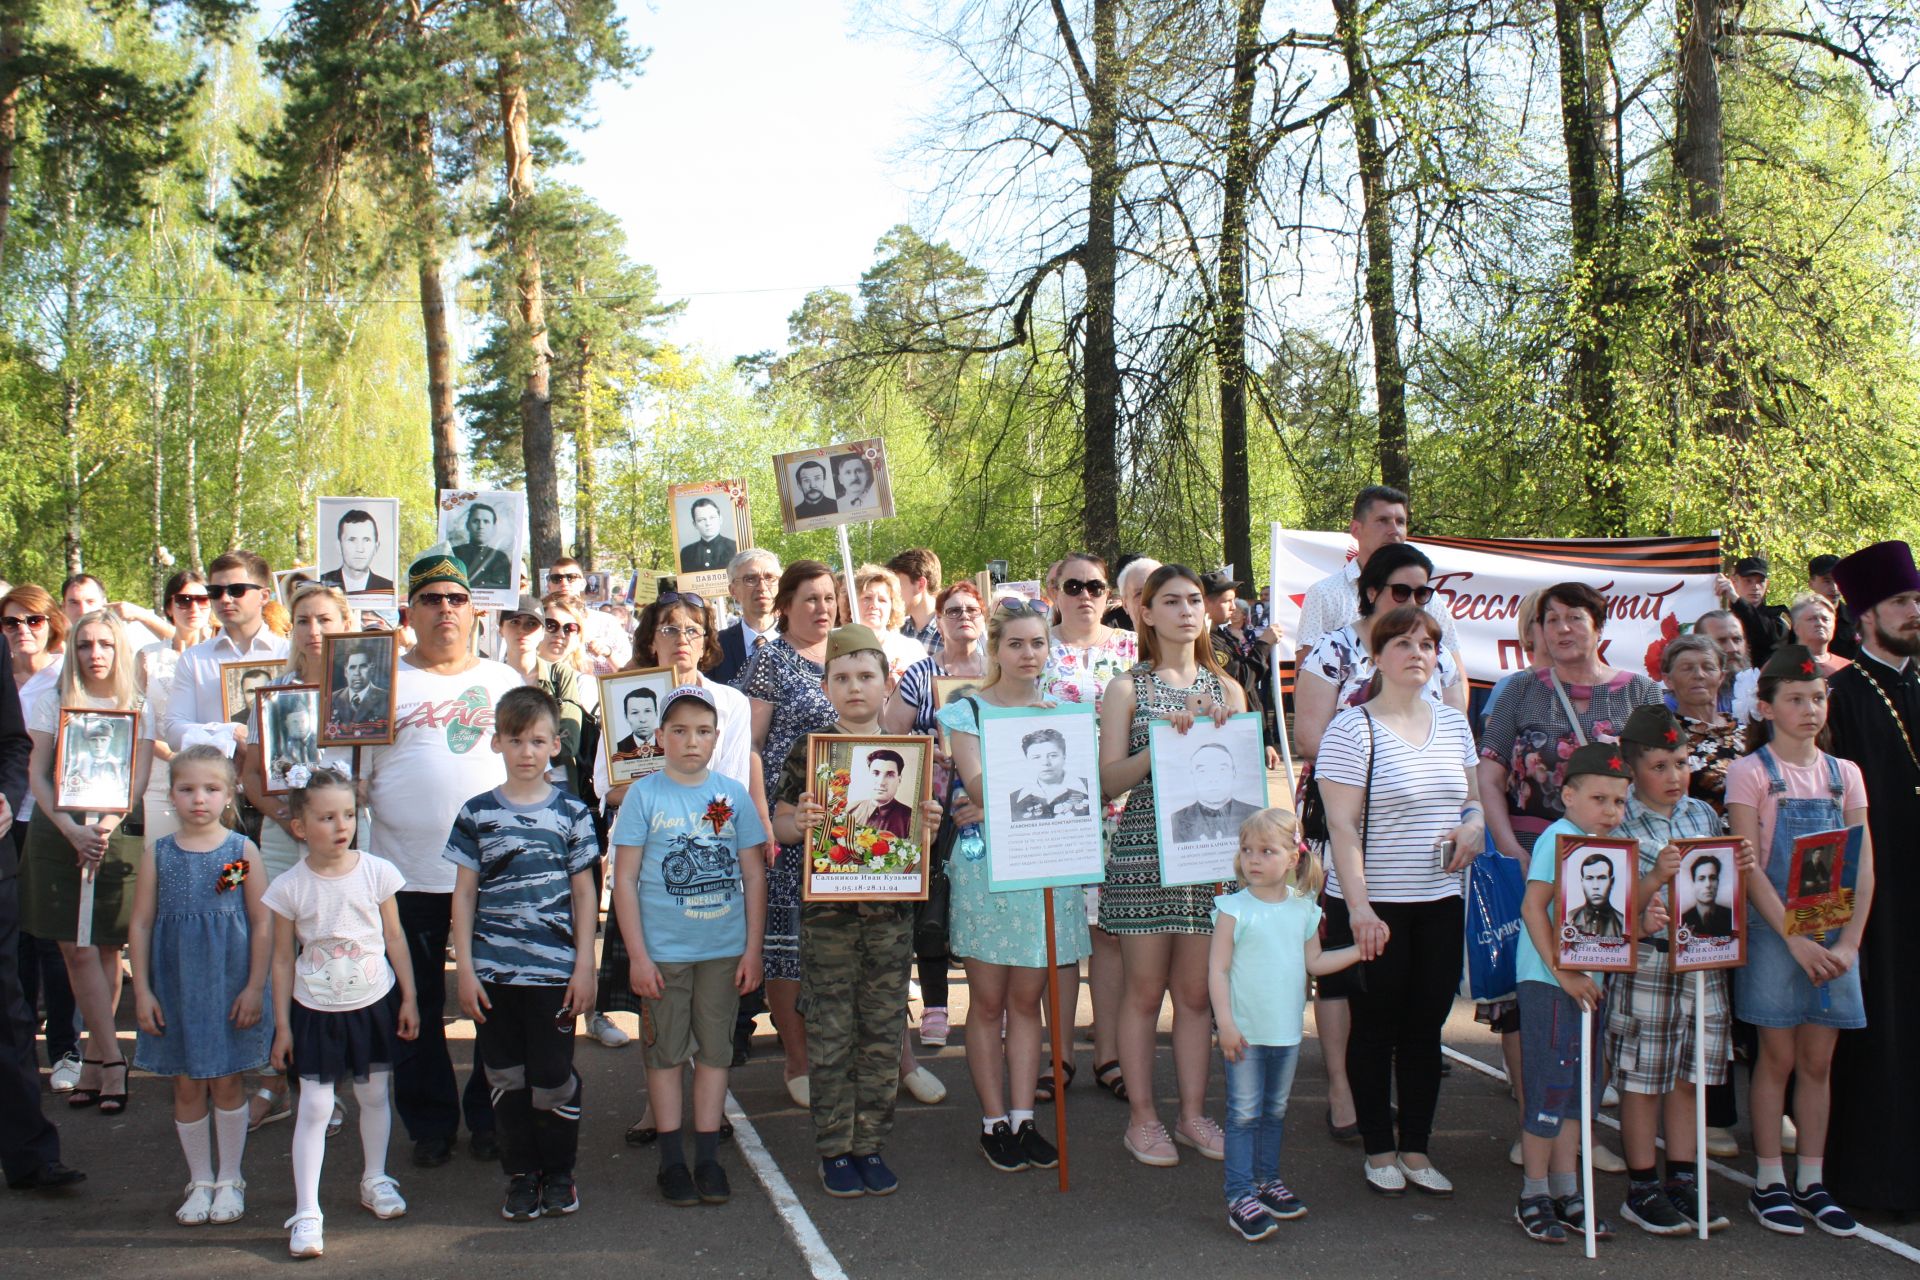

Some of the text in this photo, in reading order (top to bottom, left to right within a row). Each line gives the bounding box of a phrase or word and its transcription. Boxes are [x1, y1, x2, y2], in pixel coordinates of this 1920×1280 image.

[696, 573, 727, 583] ПАВЛОВ
[1428, 571, 1685, 620] Бессмный
[1497, 639, 1612, 670] ПК
[668, 688, 704, 701] RUSSIA
[652, 811, 685, 833] Iron
[814, 858, 859, 873] 9 МАЯ
[884, 874, 918, 882] Кузьмич
[1477, 931, 1492, 945] LC
[1576, 944, 1620, 953] Николай
[1687, 945, 1730, 954] Николай
[1570, 953, 1628, 963] Игнатьевич
[1682, 954, 1737, 963] Яковлевич
